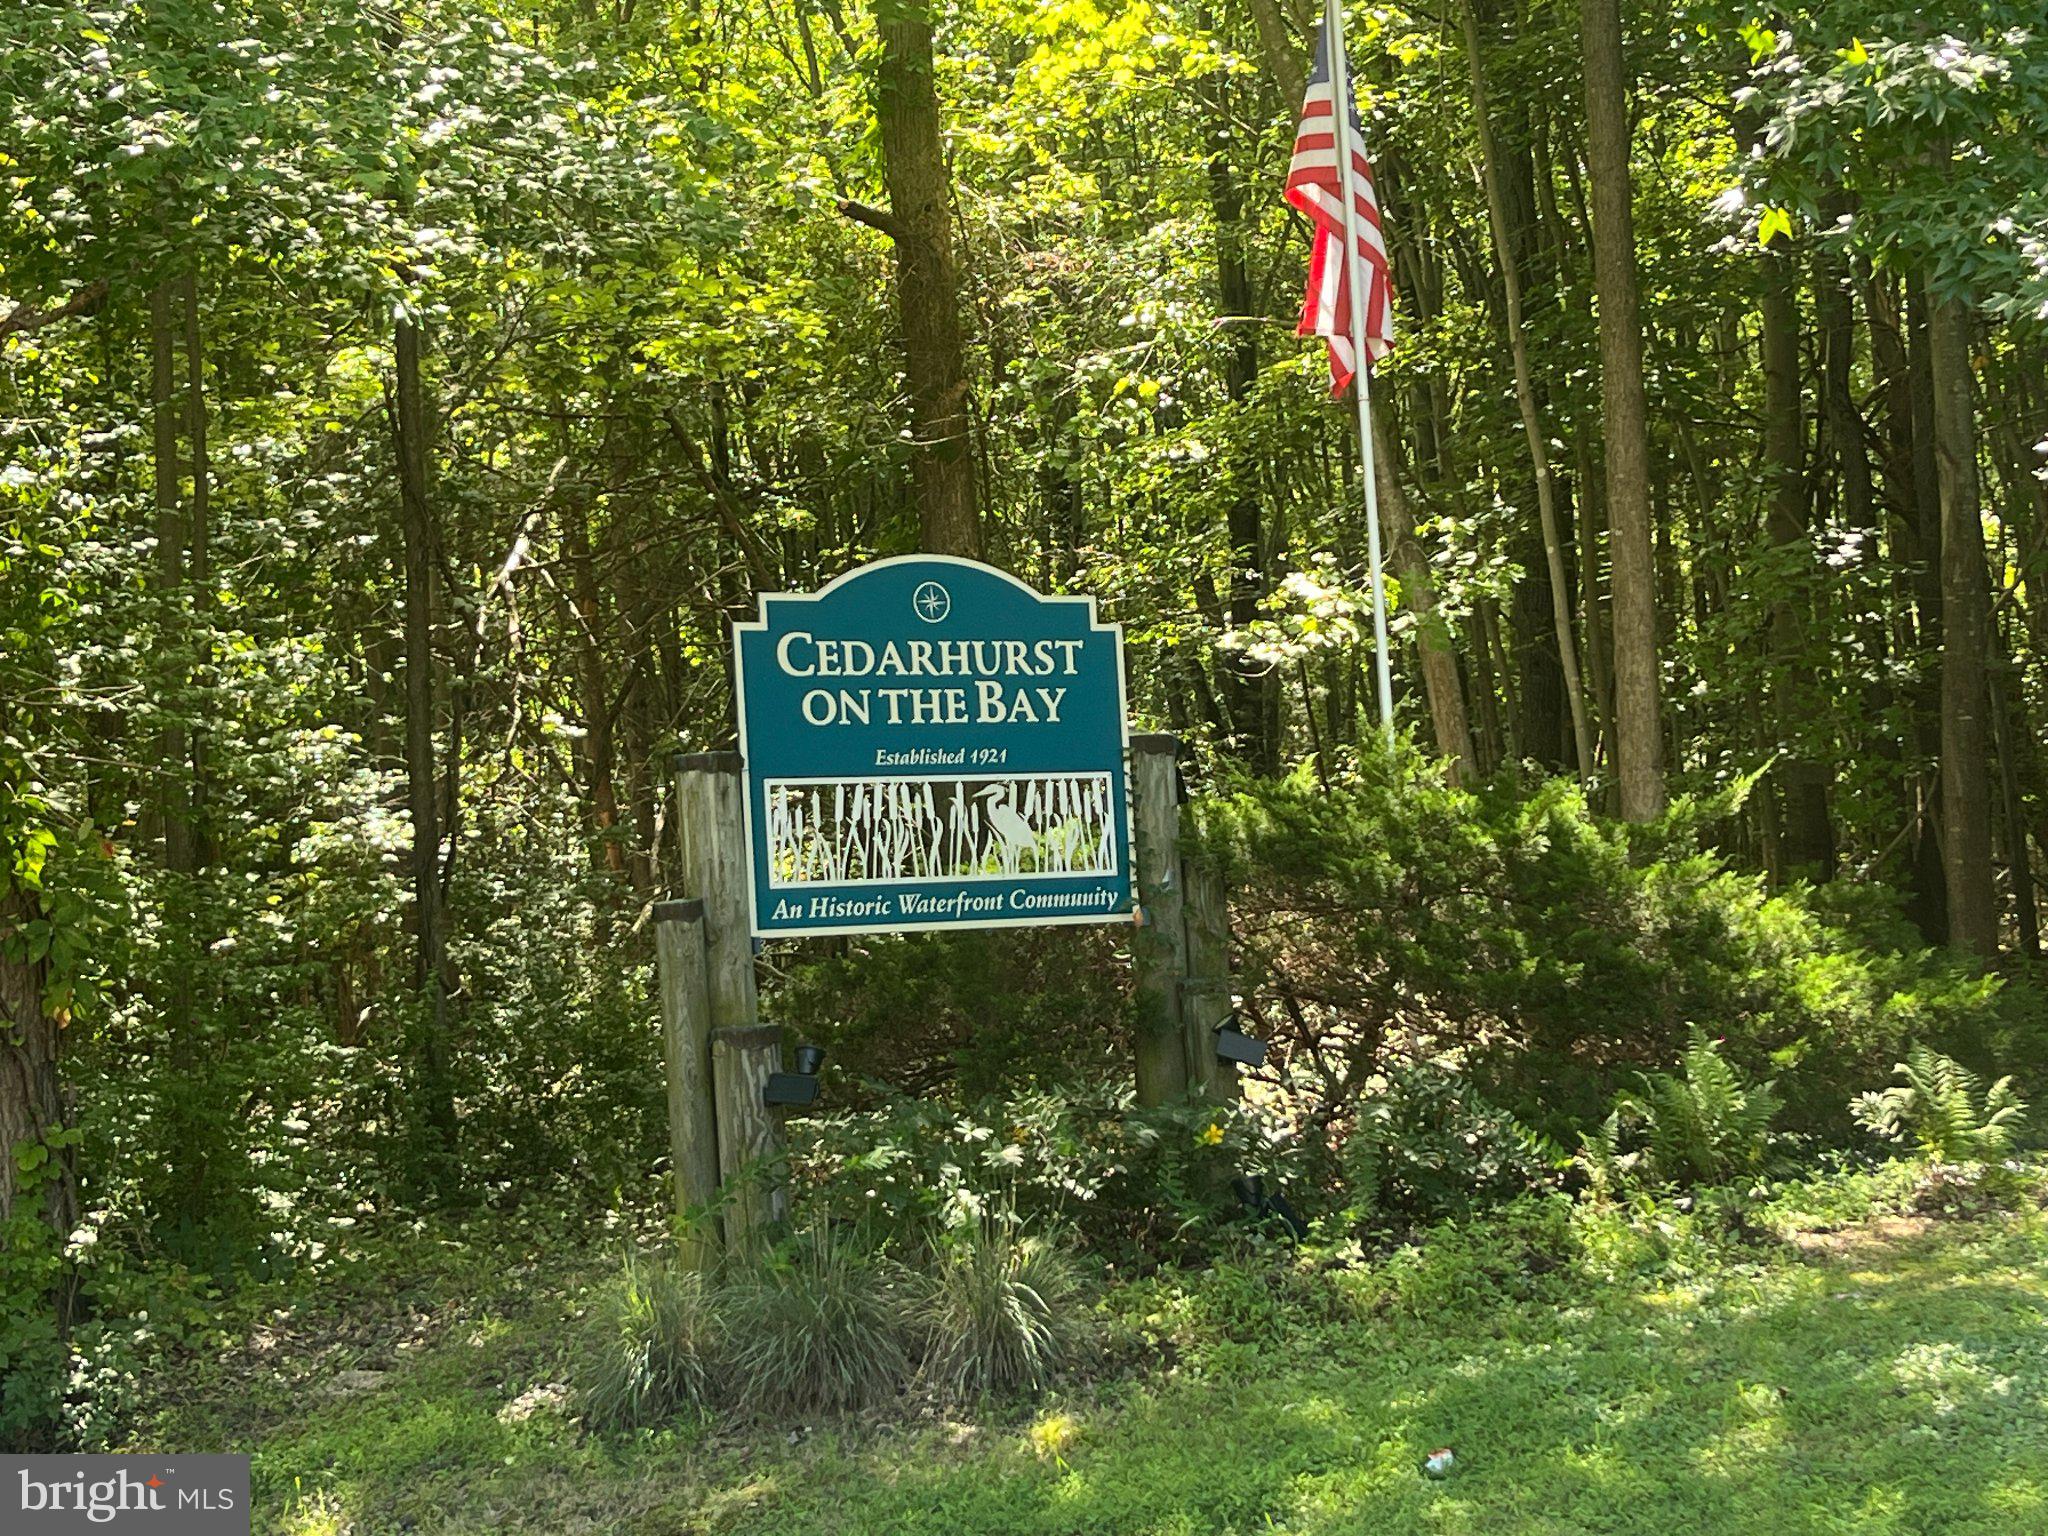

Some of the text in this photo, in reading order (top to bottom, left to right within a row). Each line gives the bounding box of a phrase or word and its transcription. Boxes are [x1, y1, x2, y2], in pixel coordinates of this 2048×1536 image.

[776, 631, 1084, 677] CEDARHURST
[801, 680, 1067, 726] ON THE BAY
[875, 747, 1008, 766] Established 1921
[771, 886, 1119, 920] An Historic Waterfront Community
